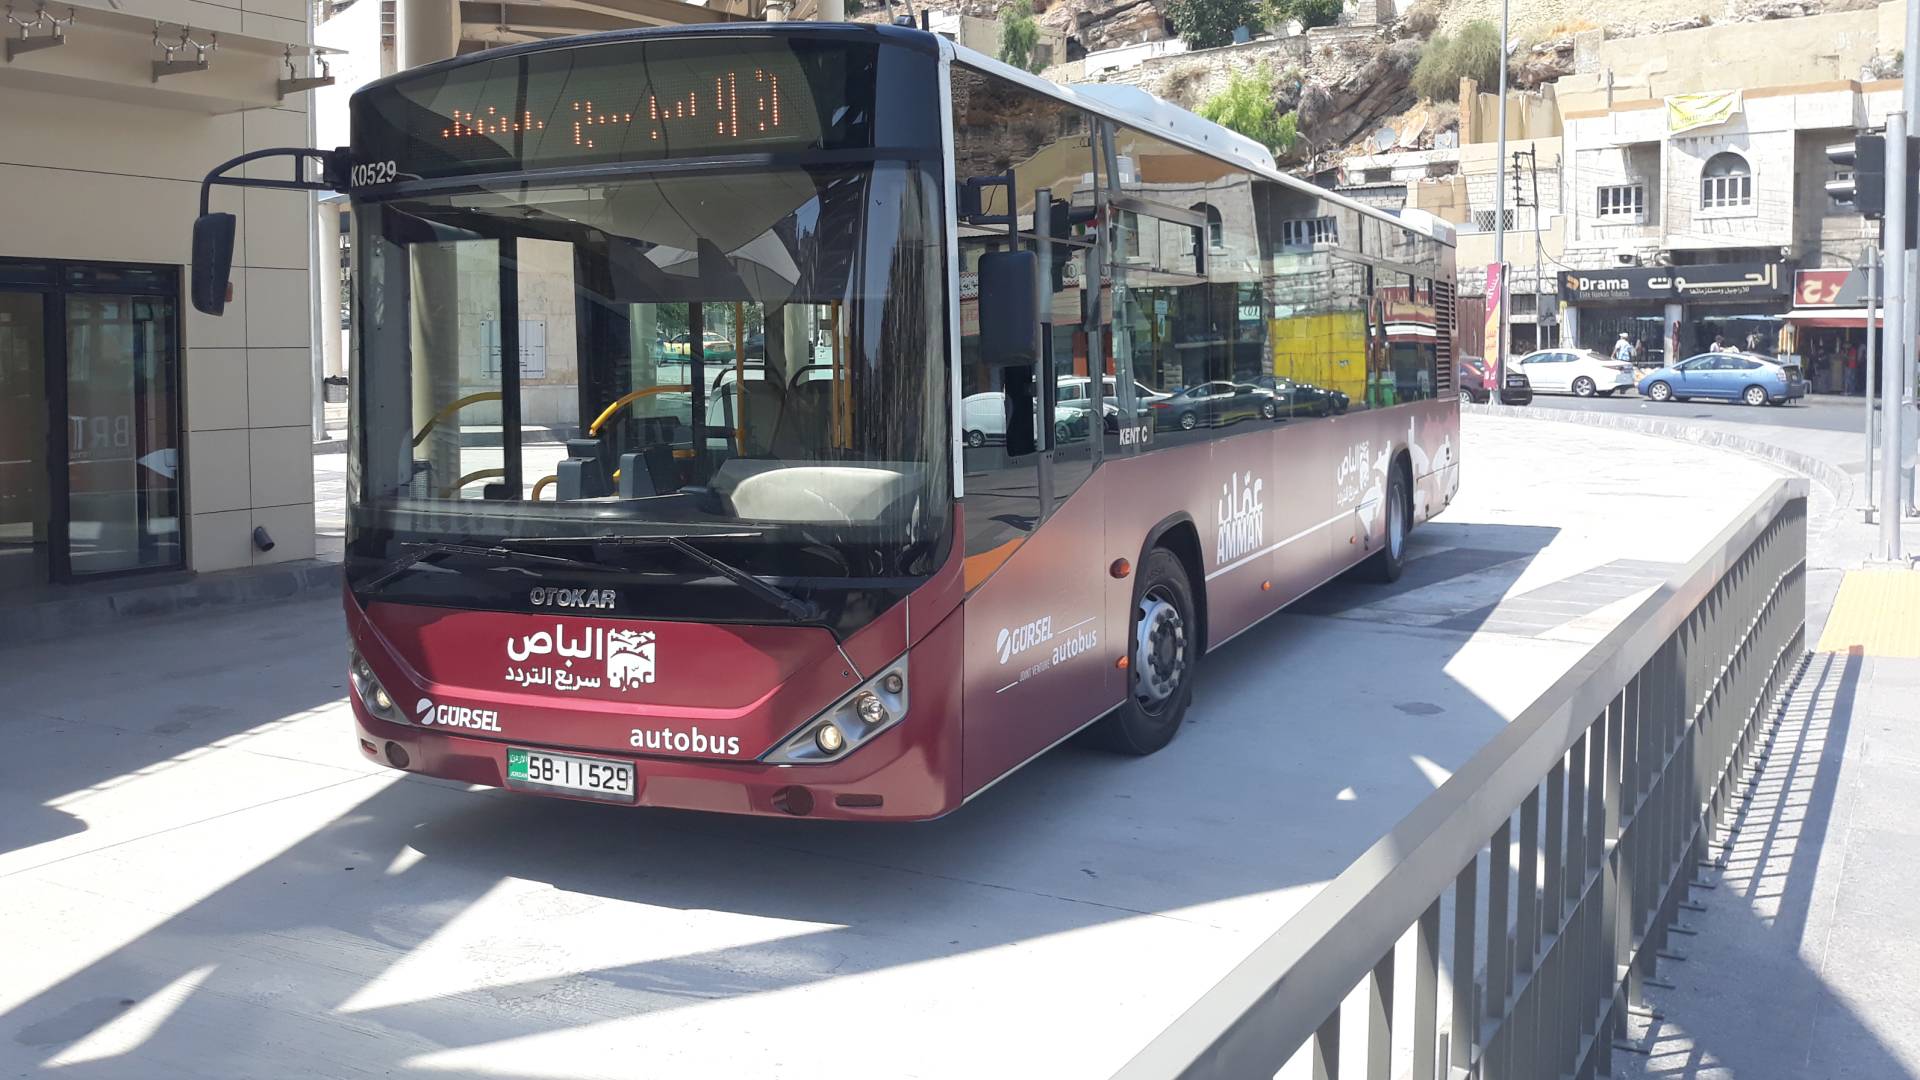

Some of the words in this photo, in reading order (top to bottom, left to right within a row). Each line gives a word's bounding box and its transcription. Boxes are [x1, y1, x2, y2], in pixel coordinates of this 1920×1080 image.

[351, 160, 397, 187] K0529
[1580, 277, 1630, 291] Drama
[1648, 263, 1777, 293] الحوت
[1119, 426, 1140, 446] KENT
[1141, 425, 1148, 442] C
[1216, 511, 1264, 566] AMMAN
[529, 586, 617, 609] OTOKAR
[507, 623, 604, 668] الباص
[1052, 629, 1097, 666] autobus
[505, 666, 552, 687] التردد
[554, 669, 601, 691] سريع
[436, 704, 502, 733] GÜRSEL
[629, 726, 741, 756] autobus
